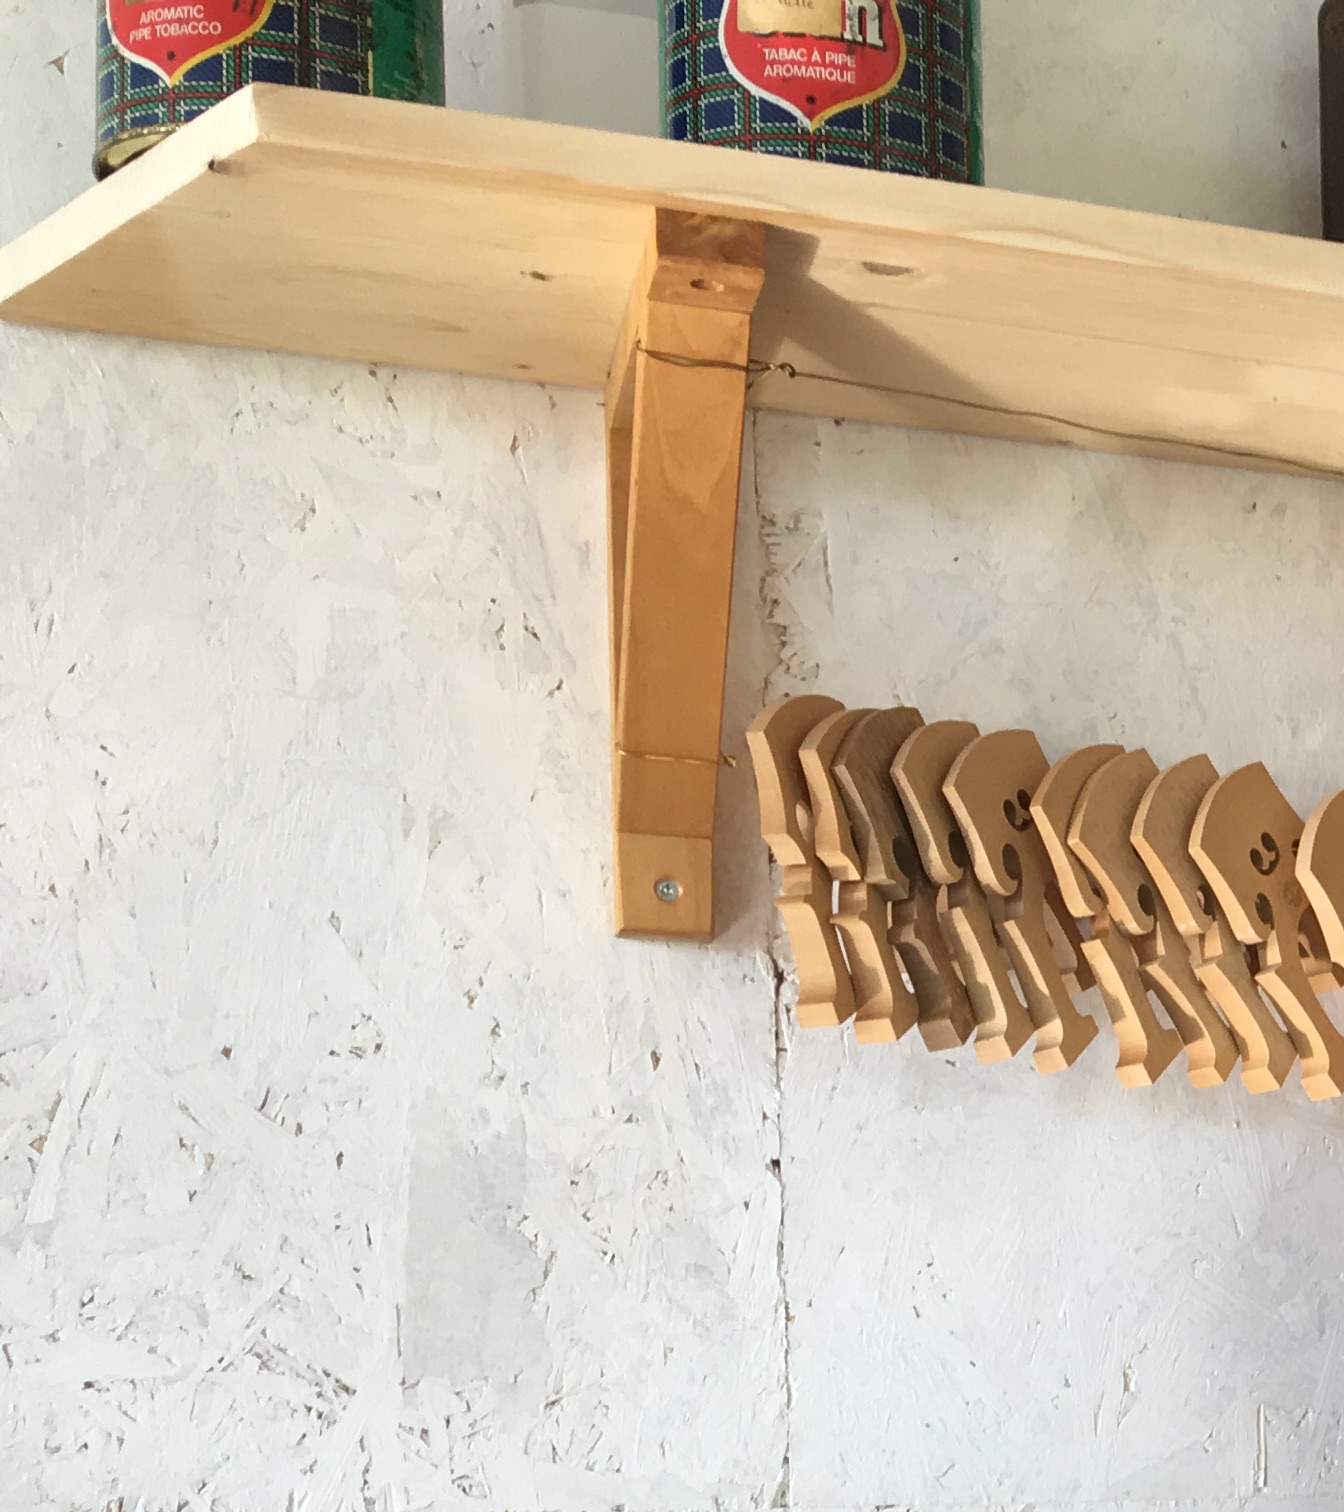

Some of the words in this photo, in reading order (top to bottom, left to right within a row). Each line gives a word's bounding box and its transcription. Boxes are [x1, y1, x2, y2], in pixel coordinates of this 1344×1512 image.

[139, 4, 205, 25] AROMATIC
[129, 26, 152, 44] PIPE
[155, 20, 222, 38] TOBACCO
[762, 48, 807, 61] TABAC
[811, 47, 822, 64] À
[825, 52, 857, 68] PIPE
[764, 64, 857, 85] AROMATIQUE
